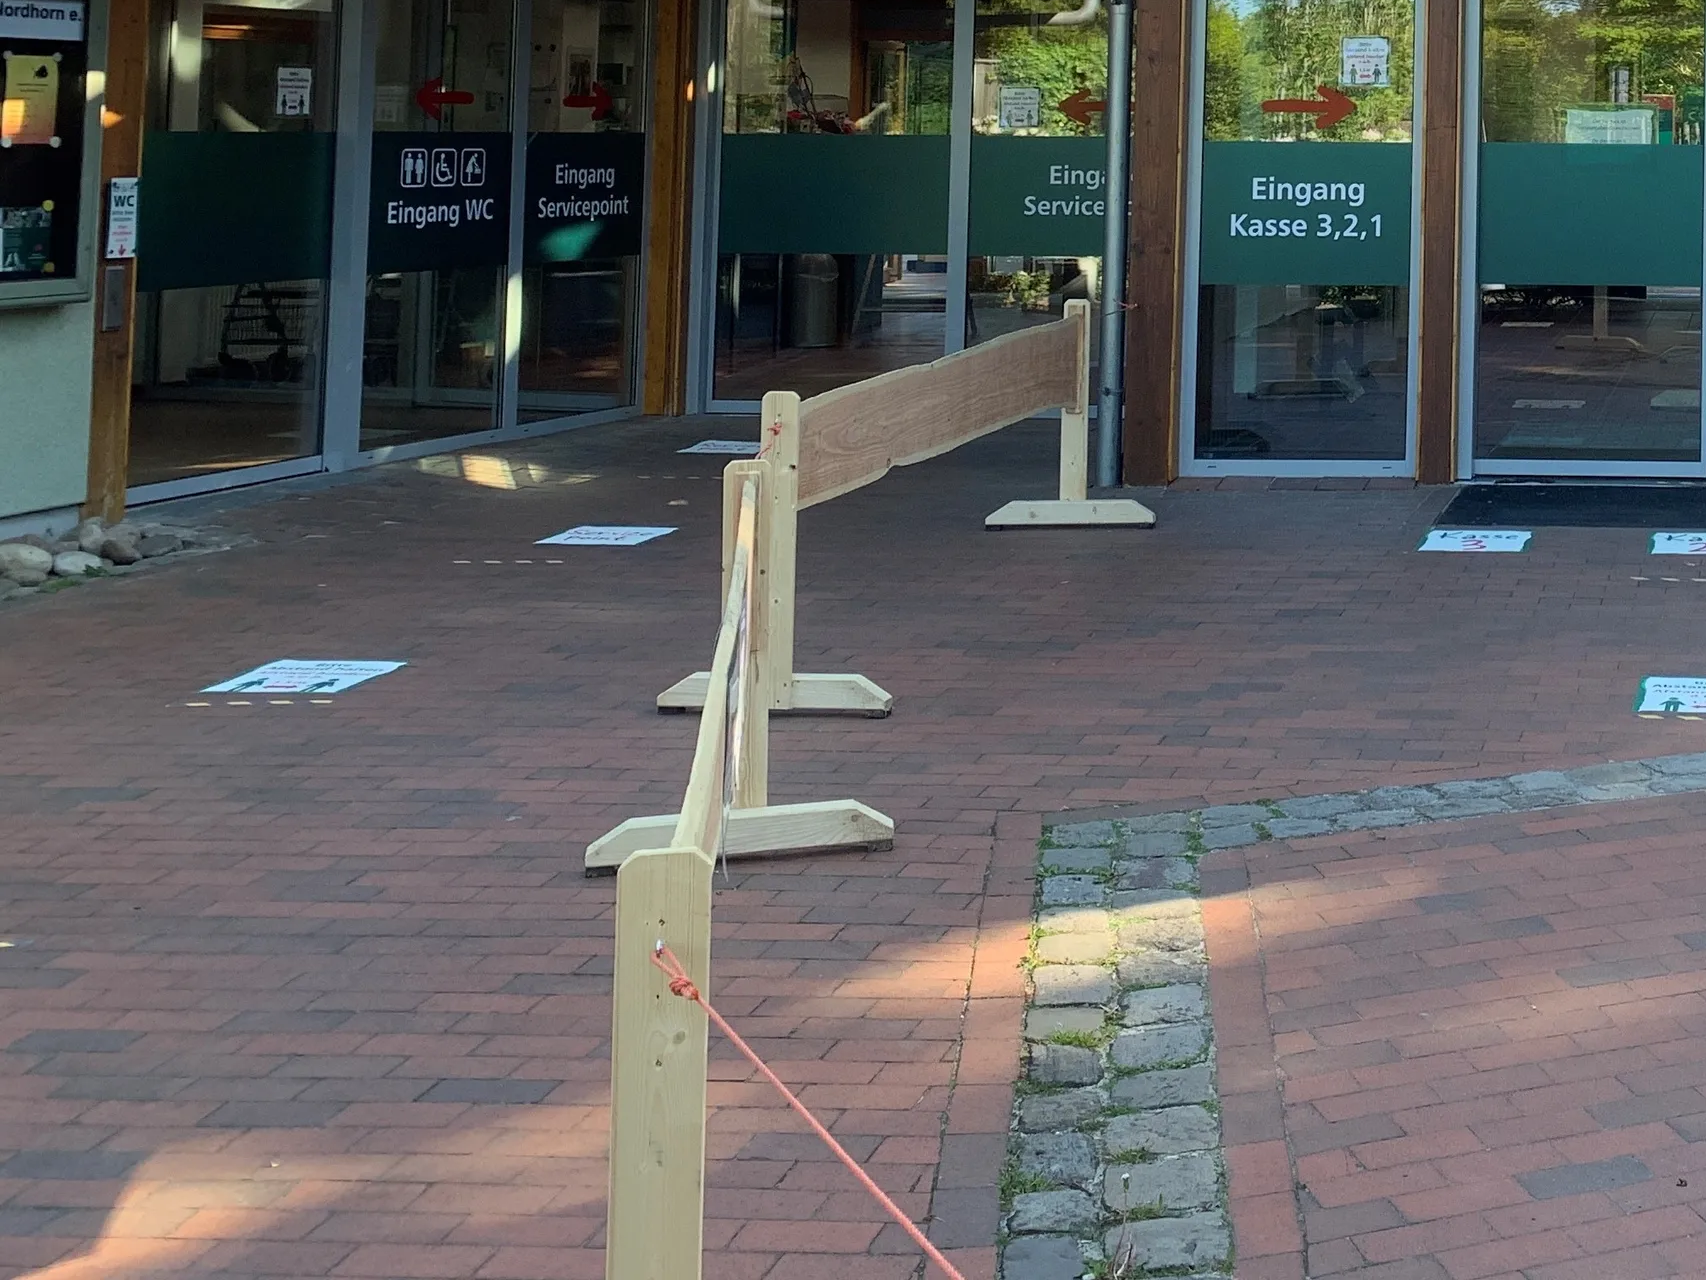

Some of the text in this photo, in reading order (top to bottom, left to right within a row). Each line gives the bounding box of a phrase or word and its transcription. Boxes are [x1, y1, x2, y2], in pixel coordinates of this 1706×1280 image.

[0, 2, 65, 20] ordhorn
[555, 163, 615, 189] Eingang
[1049, 164, 1133, 190] Eing
[113, 195, 135, 208] WC
[1251, 176, 1366, 207] Eingang
[387, 198, 494, 229] Eingang WC
[538, 195, 629, 222] Servicepoint
[1023, 195, 1133, 216] Service
[1229, 213, 1382, 241] Kasse 3,2,1
[1440, 531, 1519, 540] Kasse
[1460, 539, 1487, 551] 3
